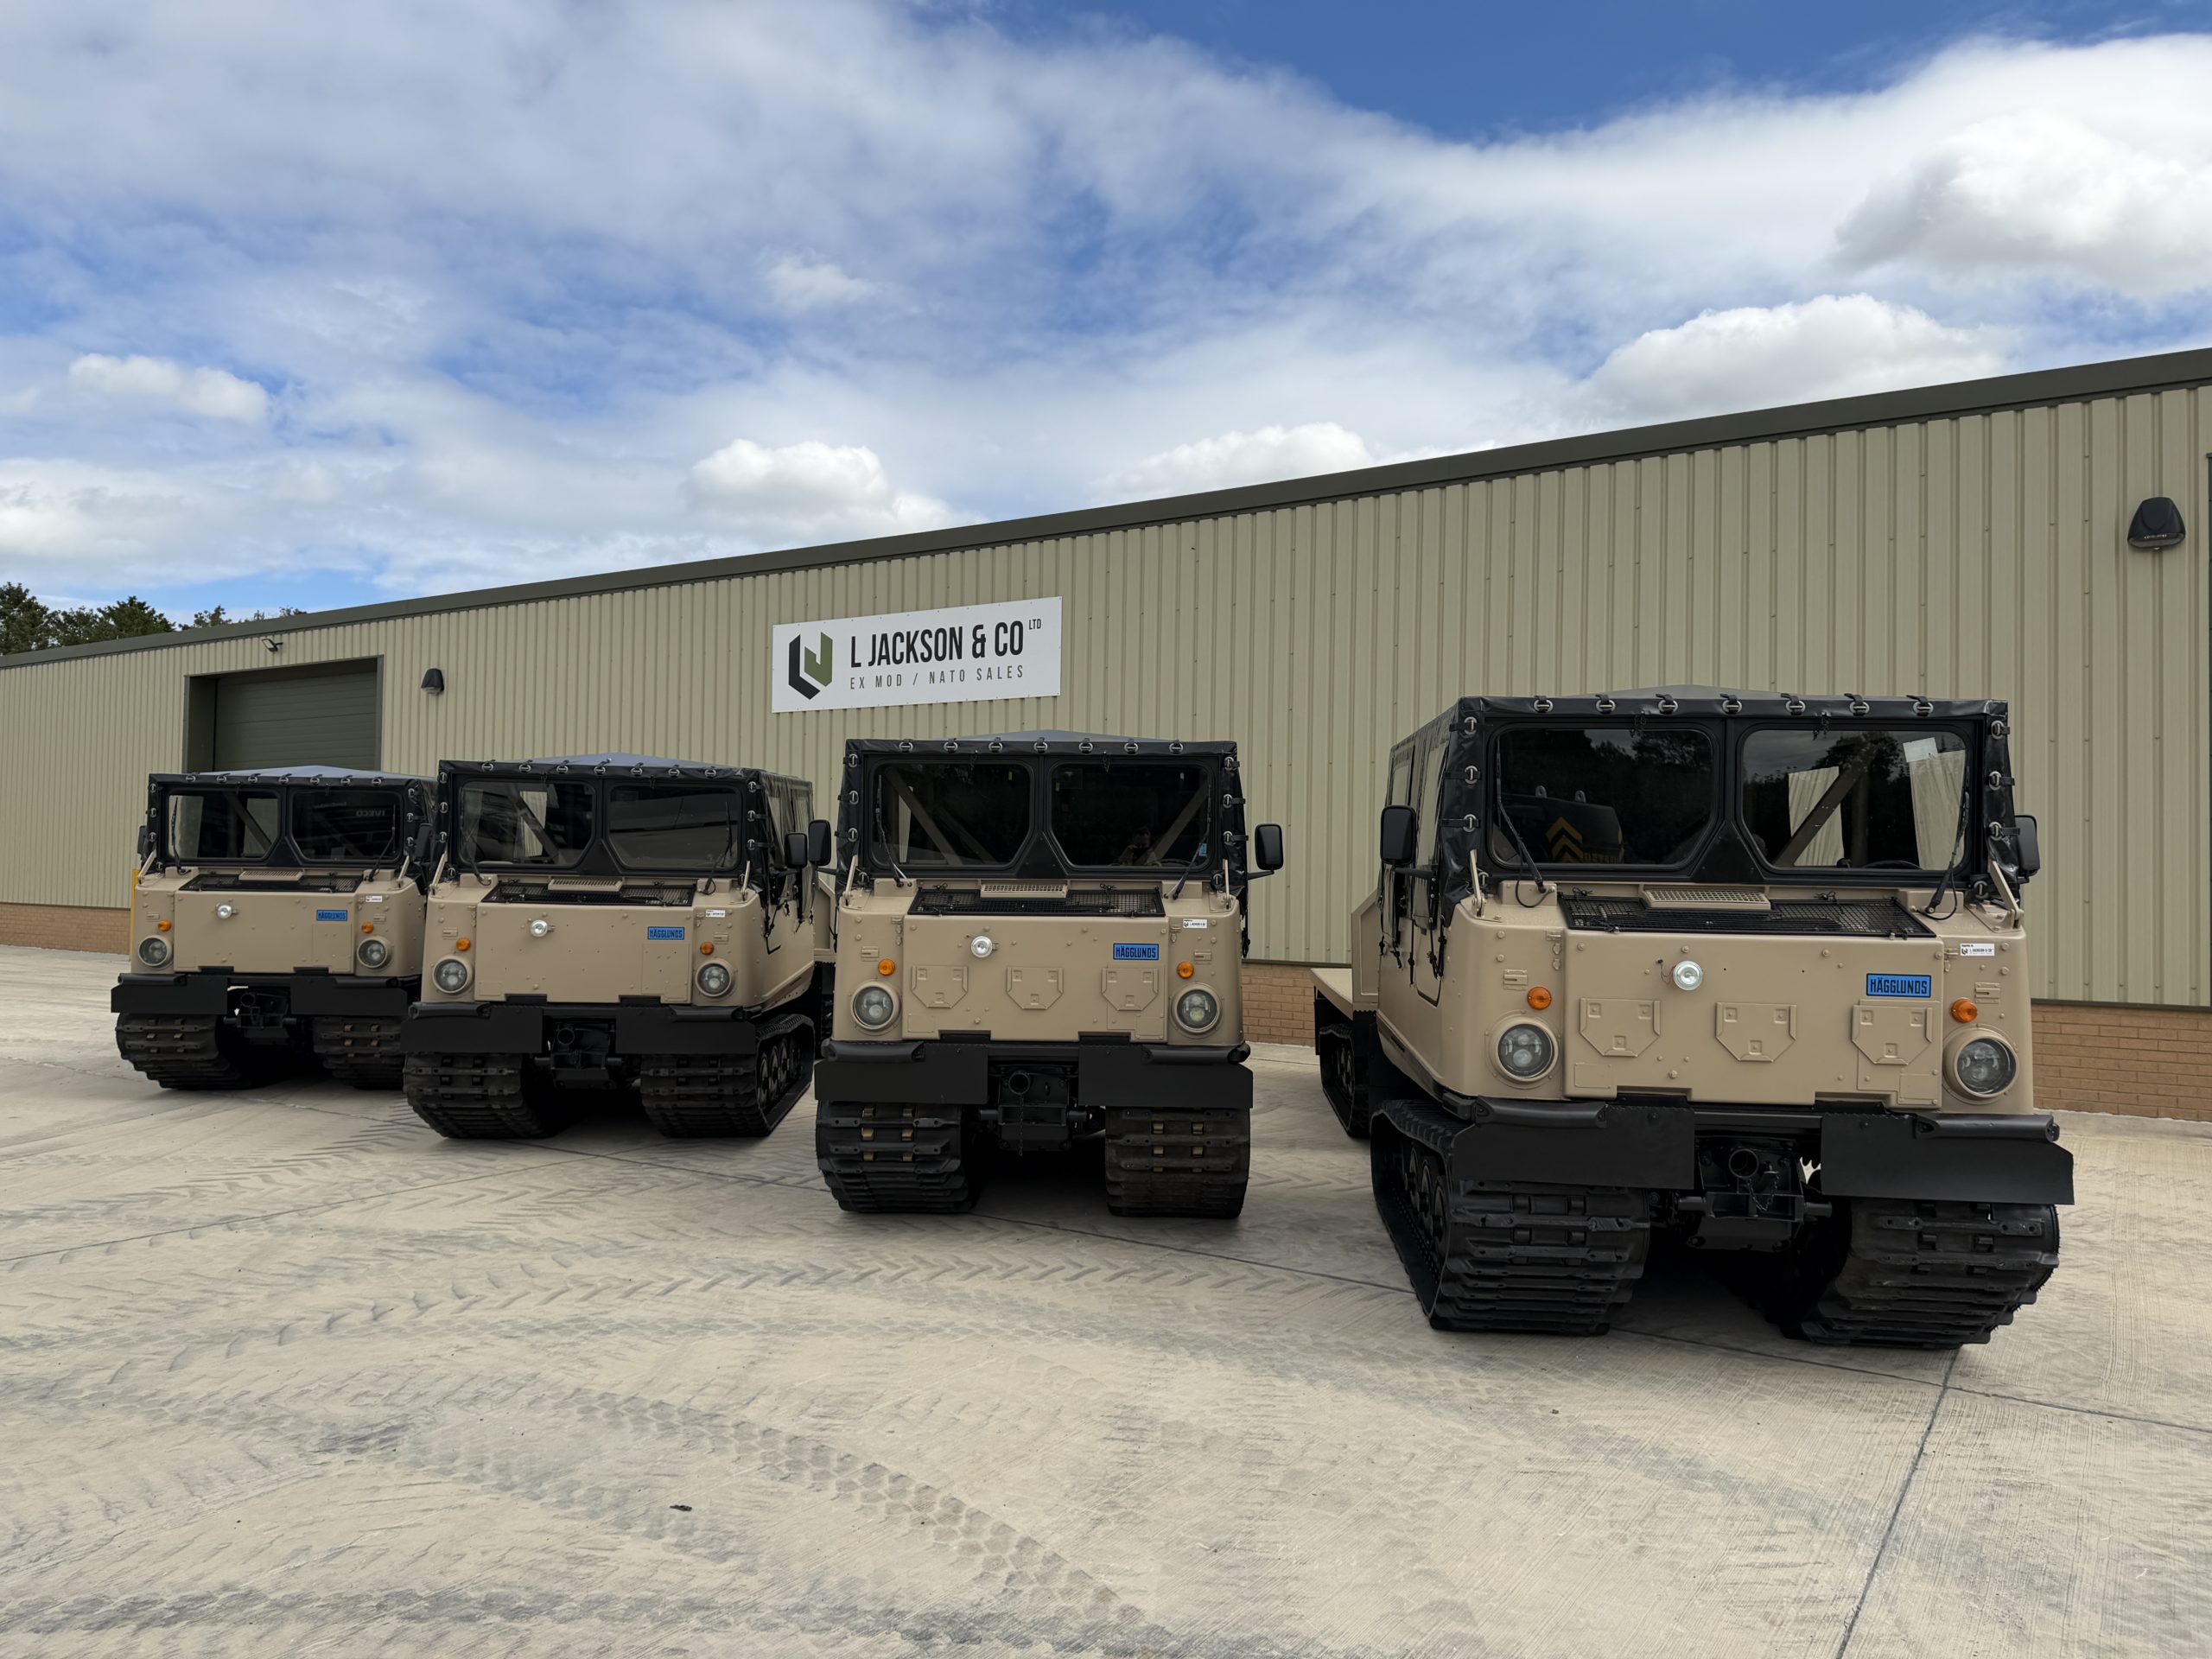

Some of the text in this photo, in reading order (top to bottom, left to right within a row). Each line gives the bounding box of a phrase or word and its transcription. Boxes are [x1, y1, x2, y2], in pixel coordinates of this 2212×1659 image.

[851, 619, 1042, 668] L JACKSON & CO LTD
[850, 676, 865, 690] EX
[875, 674, 902, 688] MOD
[929, 669, 965, 684] NATO
[976, 664, 1023, 681] SALES
[1116, 945, 1156, 958] HÄGGLUNDS
[1870, 976, 1928, 995] HÄGGLUNDS
